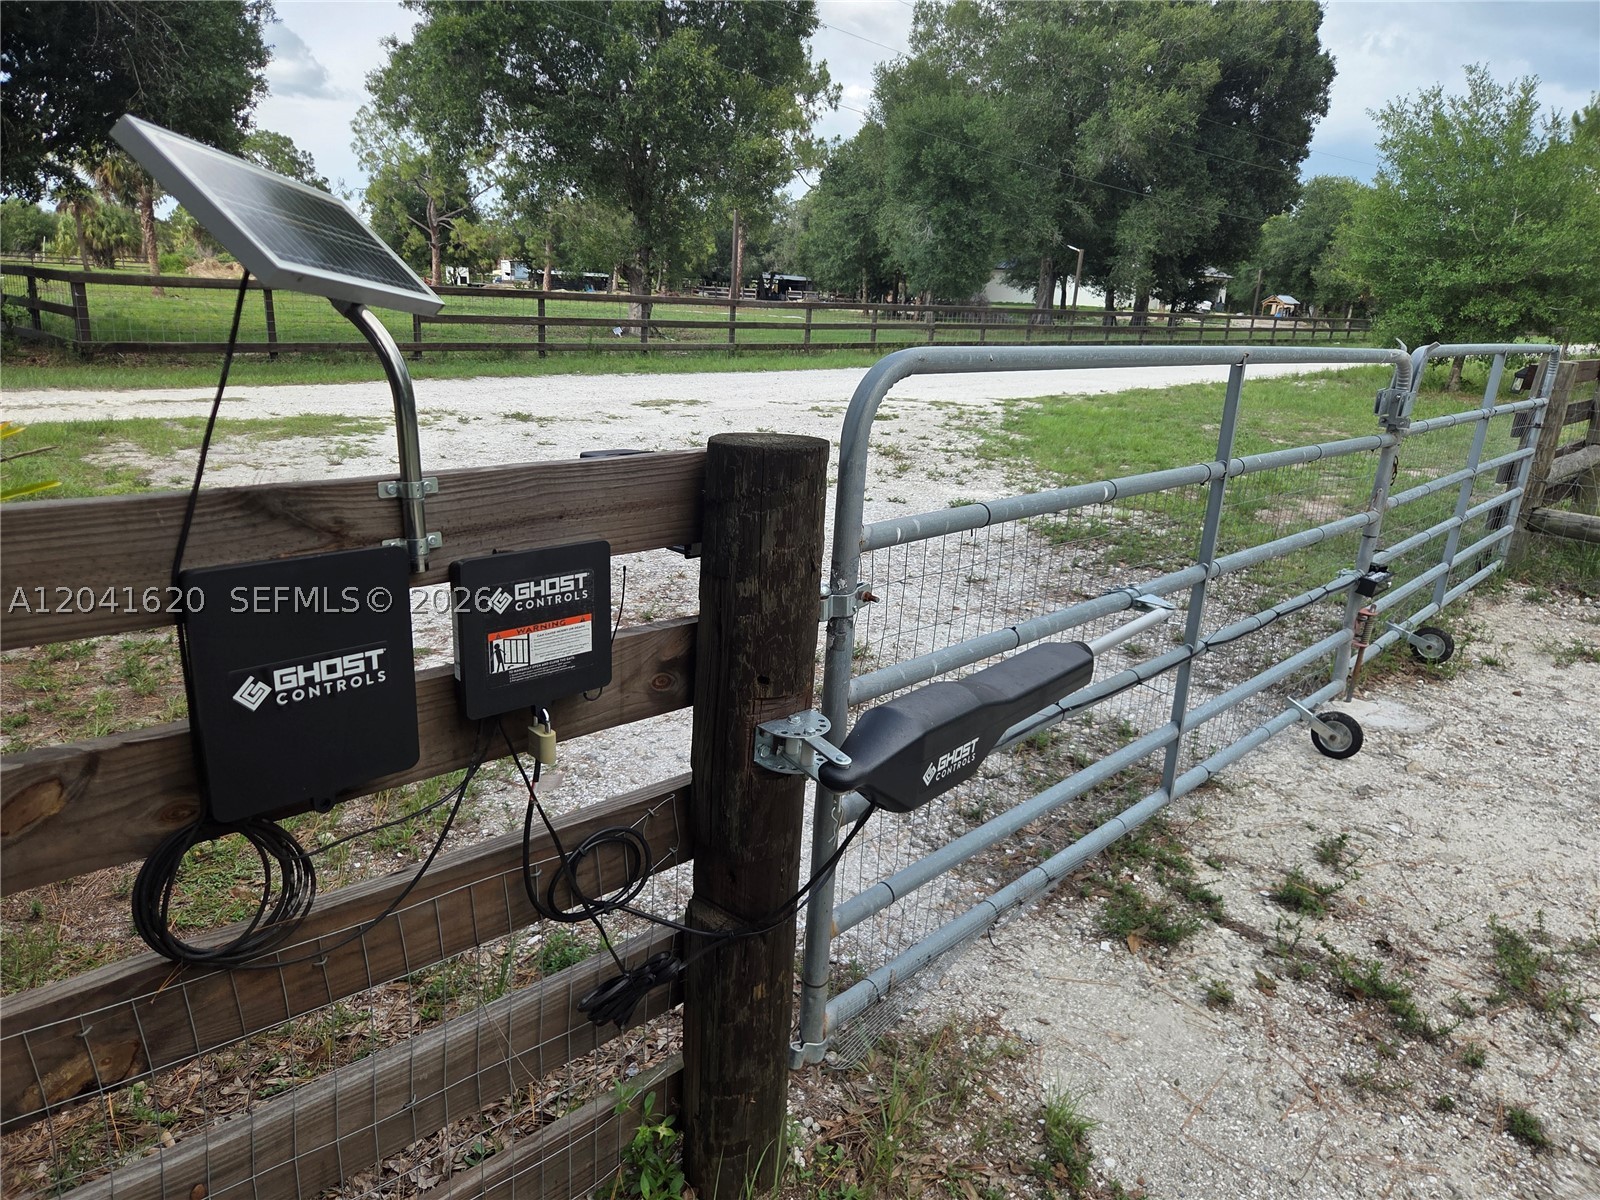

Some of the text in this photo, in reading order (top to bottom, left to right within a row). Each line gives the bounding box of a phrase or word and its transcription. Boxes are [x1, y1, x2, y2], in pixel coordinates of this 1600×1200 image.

[514, 572, 588, 600] GHOST
[515, 589, 588, 611] CONTROLS
[516, 619, 566, 635] WARNING
[273, 648, 385, 692] GHOST
[276, 670, 386, 705] CONTROLS
[935, 752, 976, 781] CONTROLS
[937, 737, 980, 772] GHOST
